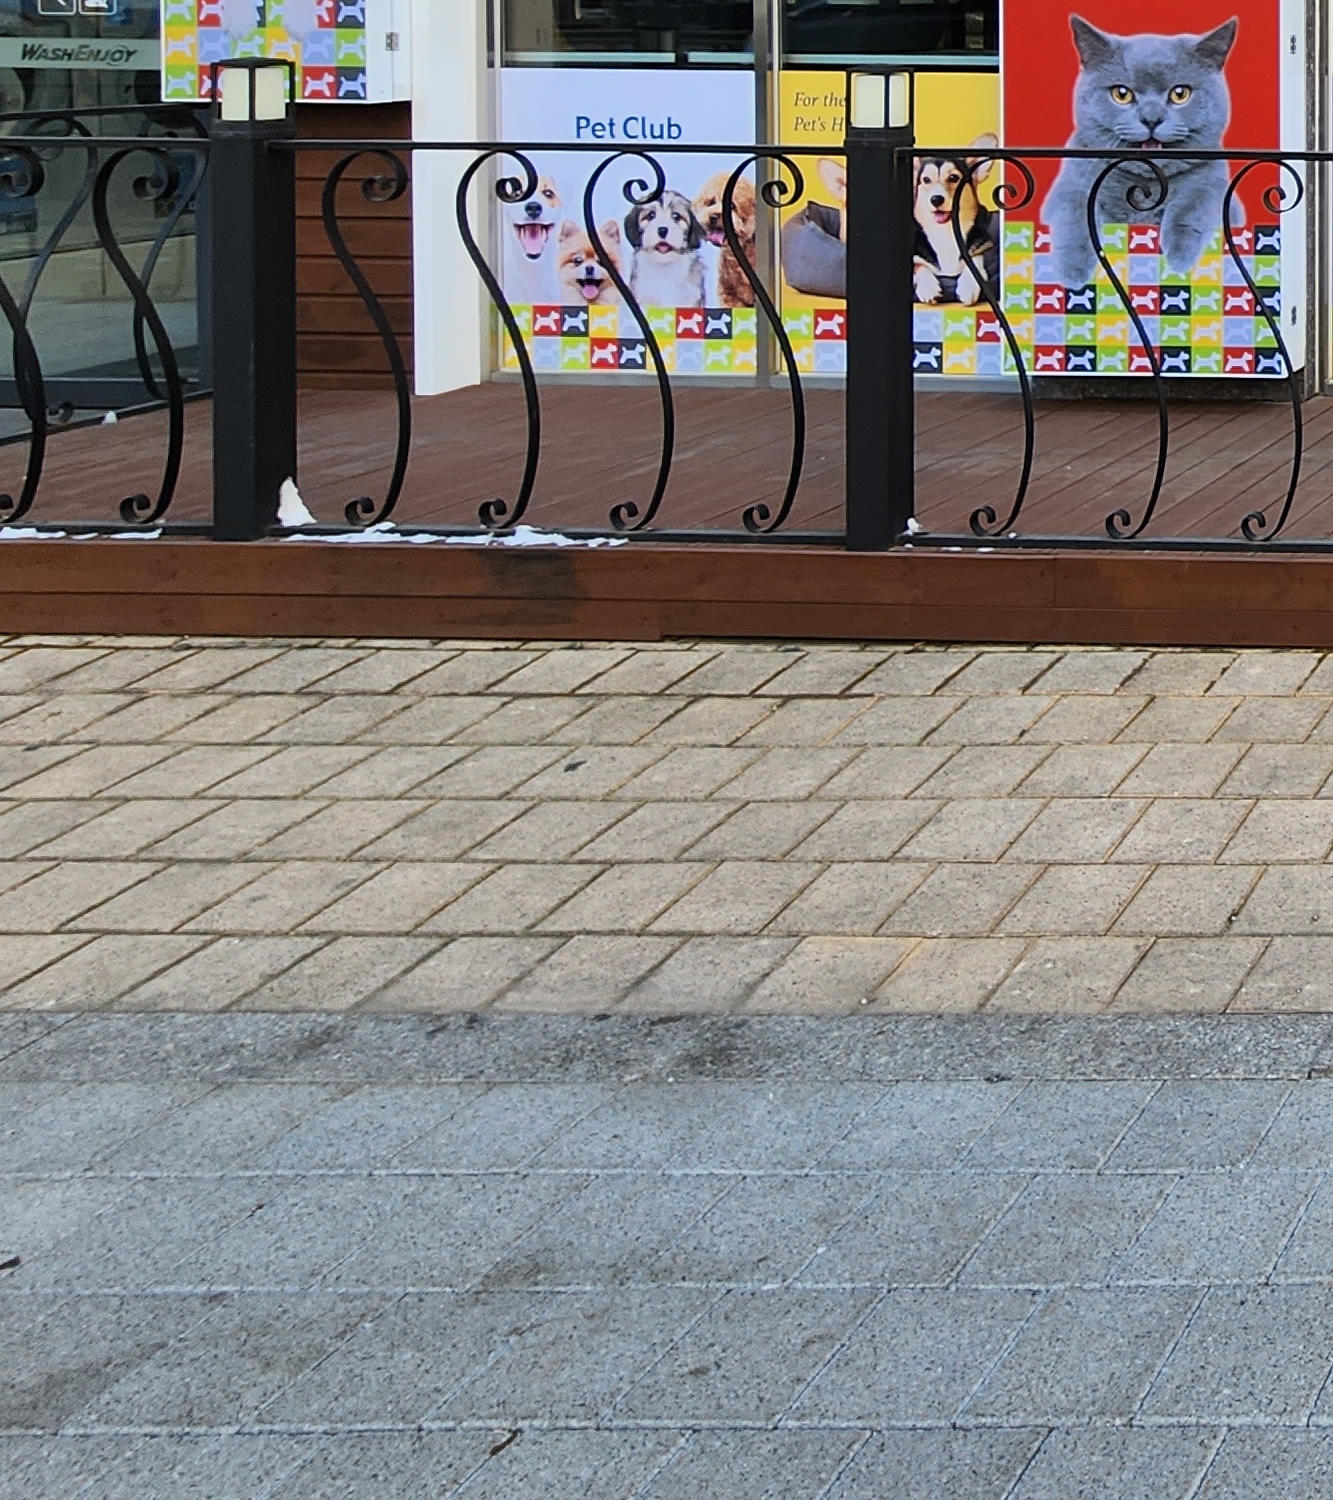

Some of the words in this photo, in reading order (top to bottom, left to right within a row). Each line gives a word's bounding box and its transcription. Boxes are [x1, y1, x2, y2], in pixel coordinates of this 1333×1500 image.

[793, 92, 819, 107] For
[822, 92, 846, 107] the
[575, 116, 616, 139] Pet
[622, 116, 683, 140] Club
[793, 116, 826, 132] Pet's
